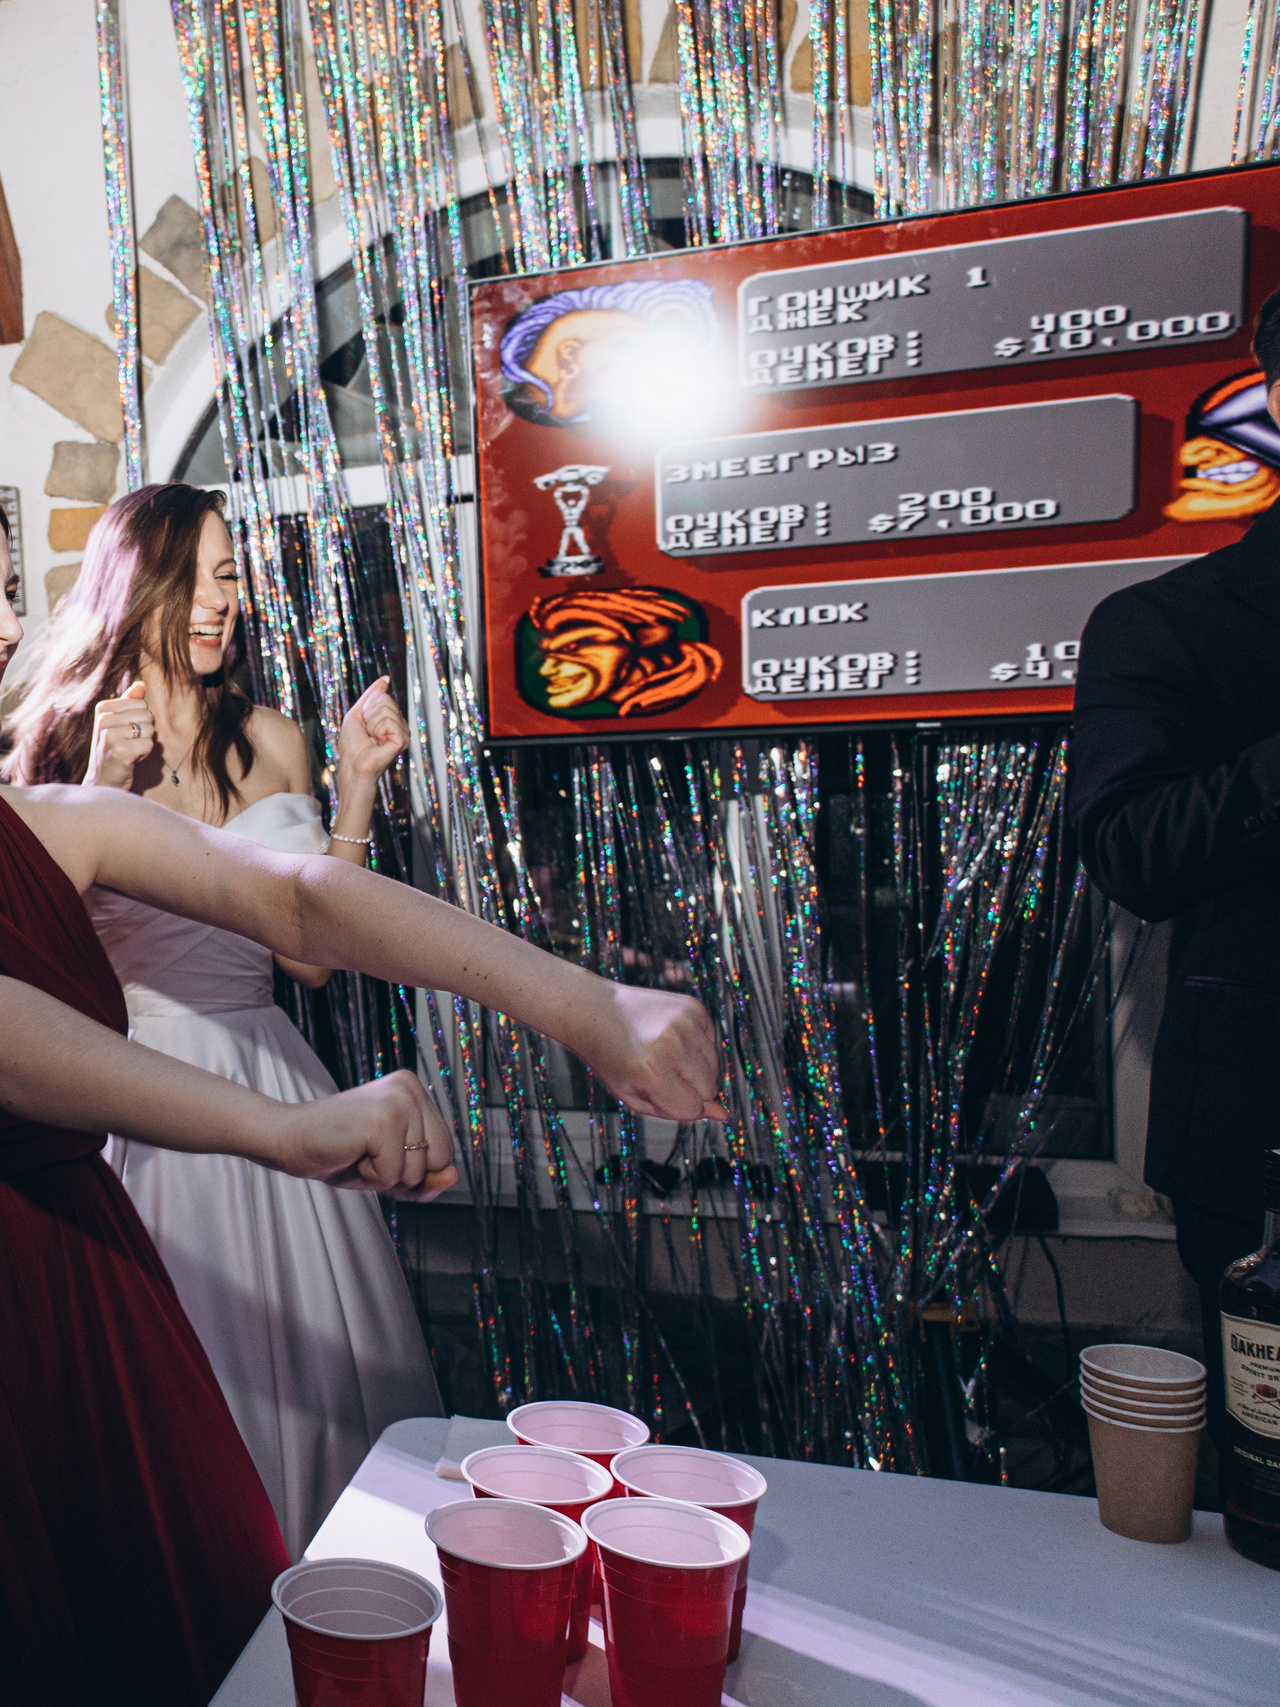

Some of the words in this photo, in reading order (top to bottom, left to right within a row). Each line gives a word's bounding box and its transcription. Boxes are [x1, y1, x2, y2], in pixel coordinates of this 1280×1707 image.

[966, 266, 988, 288] 1
[748, 302, 864, 334] ДЖЕК
[1030, 304, 1127, 333] 400
[665, 442, 897, 484] ЗМЕЕГРЫЗ
[898, 486, 993, 512] 200
[751, 602, 865, 628] КЛОК
